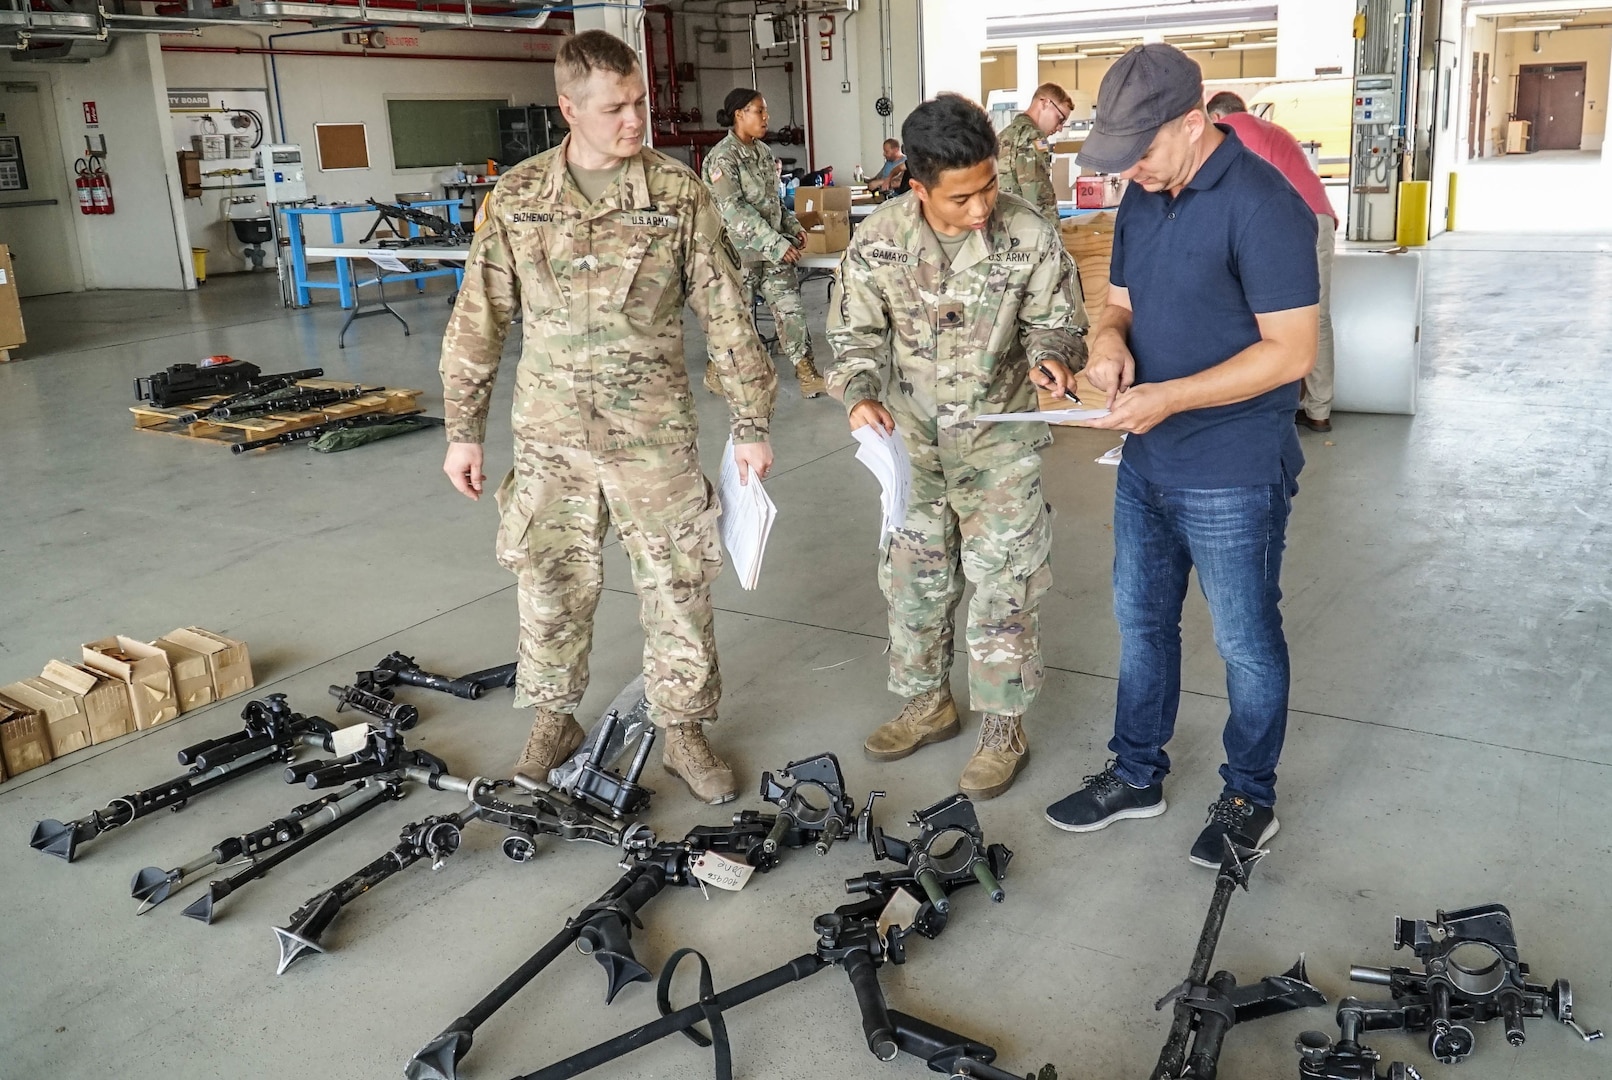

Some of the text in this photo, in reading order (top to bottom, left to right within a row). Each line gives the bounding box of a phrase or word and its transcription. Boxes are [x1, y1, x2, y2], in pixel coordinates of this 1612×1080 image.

[1081, 186, 1094, 197] 20
[513, 212, 555, 223] BAZHENOV
[646, 216, 669, 227] ARMY
[872, 248, 908, 263] GAMAYO
[1005, 252, 1031, 262] ARMY
